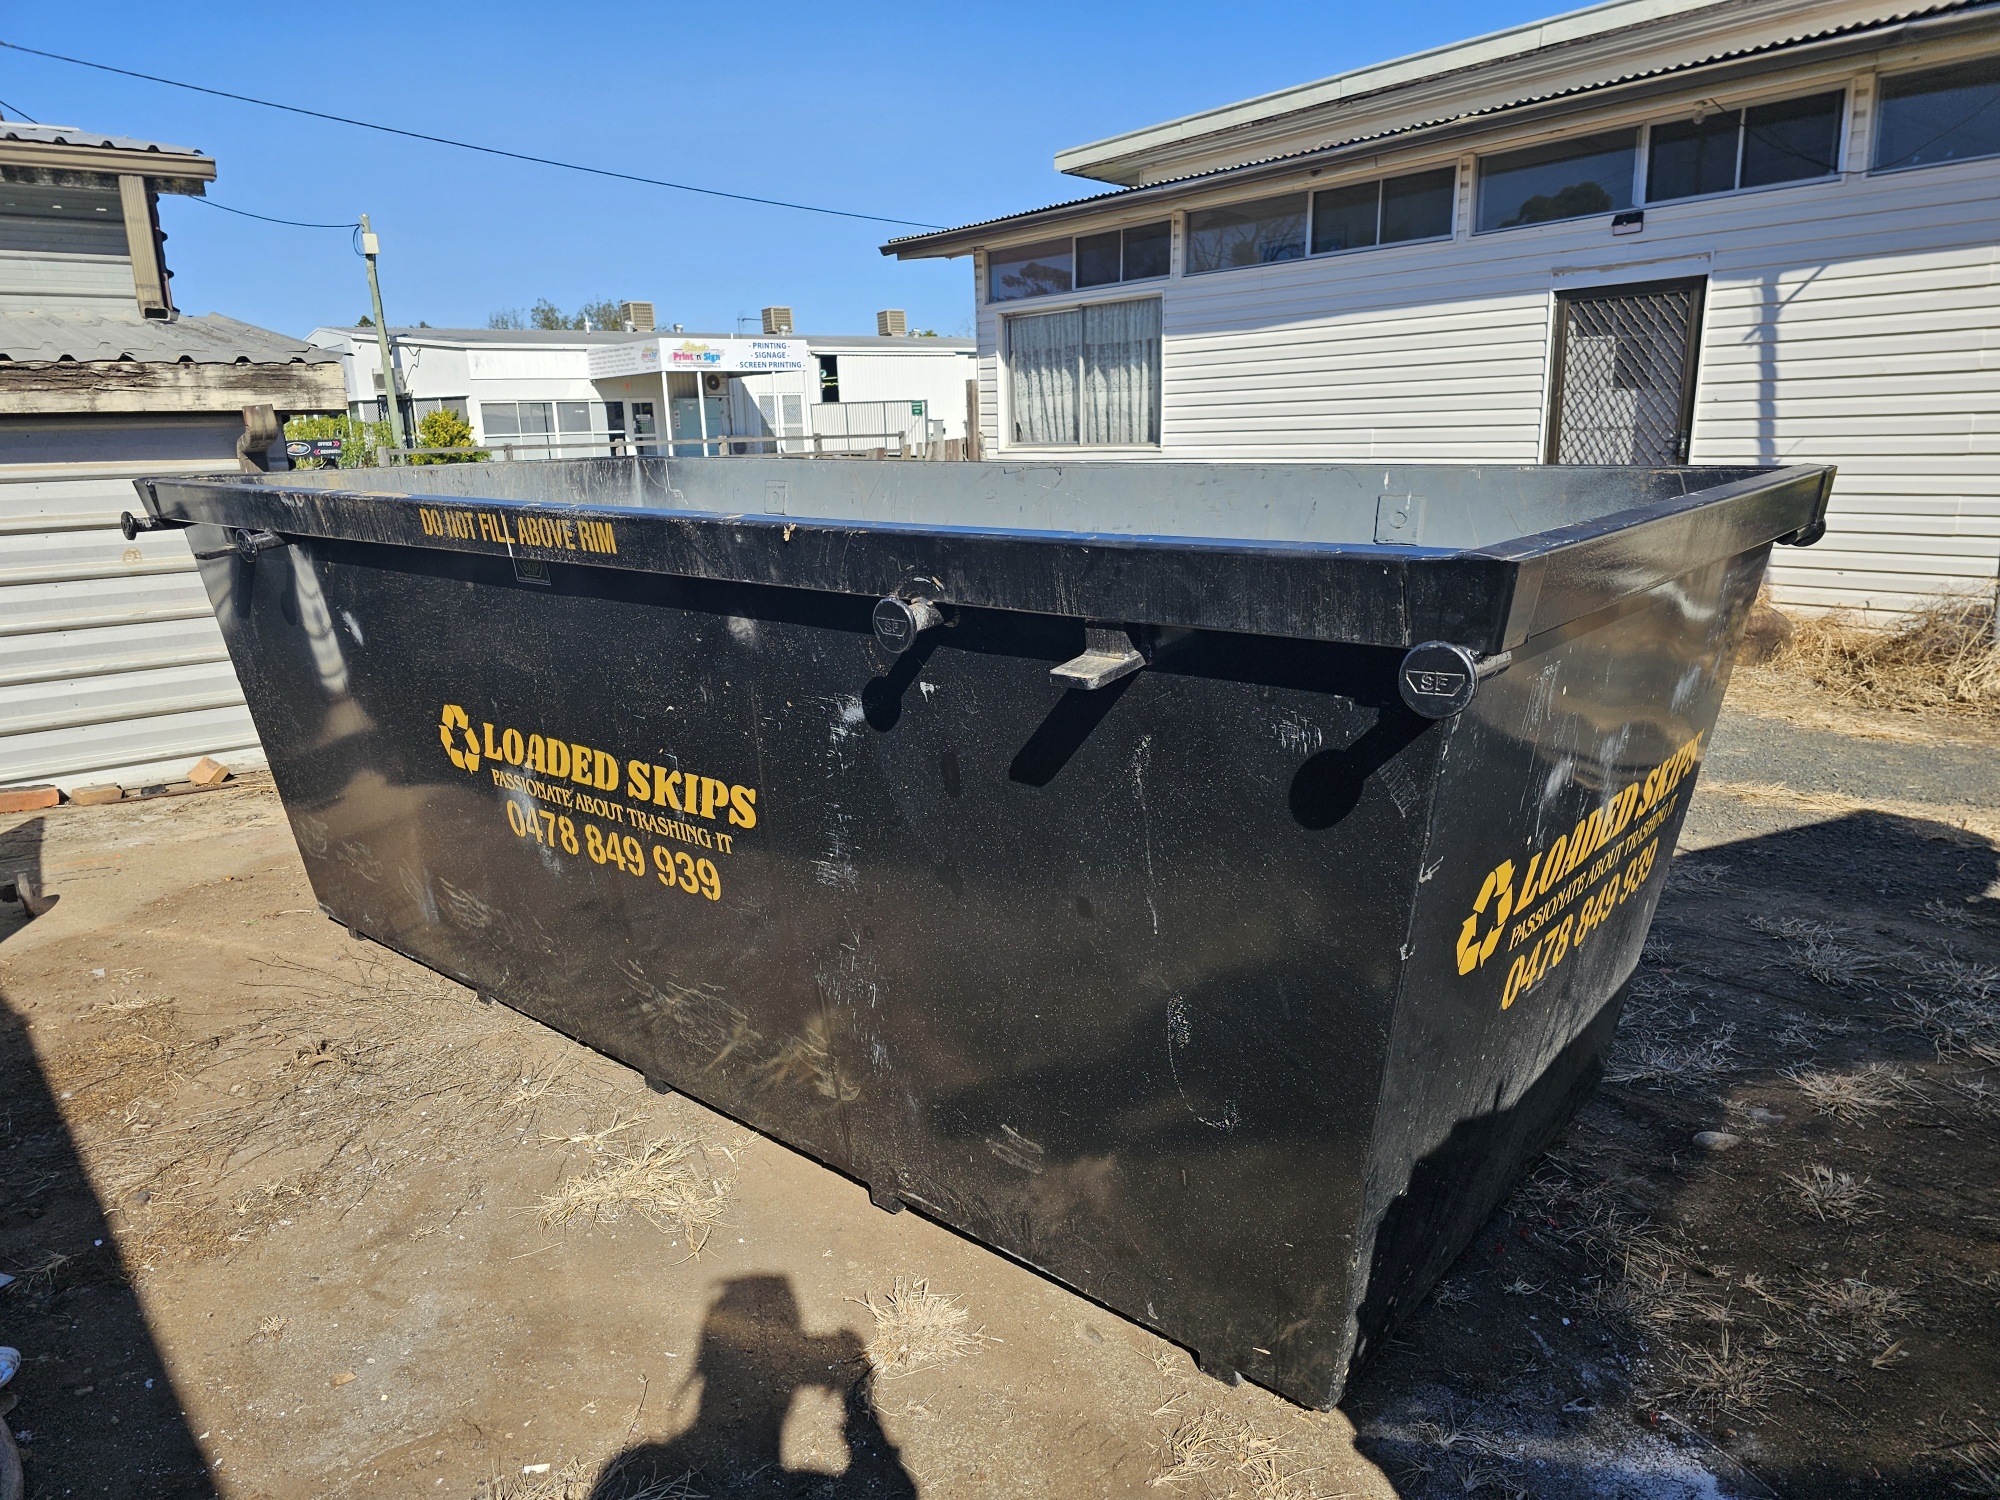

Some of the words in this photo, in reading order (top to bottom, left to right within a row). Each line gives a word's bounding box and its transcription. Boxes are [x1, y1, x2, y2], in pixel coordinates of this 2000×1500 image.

[673, 352, 694, 361] Print
[703, 352, 721, 363] Sign
[752, 342, 787, 350] PRINTING
[754, 351, 786, 359] SIGNAGE
[420, 508, 444, 537] DO
[444, 511, 476, 540] NOT
[478, 513, 516, 545] FILL
[517, 516, 577, 550] ABOVE
[577, 520, 618, 555] RIM
[523, 561, 540, 573] SKIP
[1421, 673, 1449, 692] SF
[483, 722, 620, 792] LOADED
[628, 759, 757, 829] SKIPS
[491, 768, 573, 808] PASSIONATE
[575, 792, 624, 823] ABOUT
[626, 807, 712, 848] TRASHING
[713, 831, 733, 854] IT
[1513, 782, 1640, 915] LOADED
[1634, 728, 1704, 821] SKIPS
[506, 800, 579, 855] 0478
[585, 824, 646, 877] 849
[652, 845, 722, 902] 939
[1508, 871, 1586, 952] PASSIONATE
[1585, 841, 1625, 890] ABOUT
[1624, 802, 1669, 857] TRASHING
[1501, 913, 1574, 1010] 0478
[1573, 872, 1621, 947] 849
[1619, 836, 1659, 905] 939
